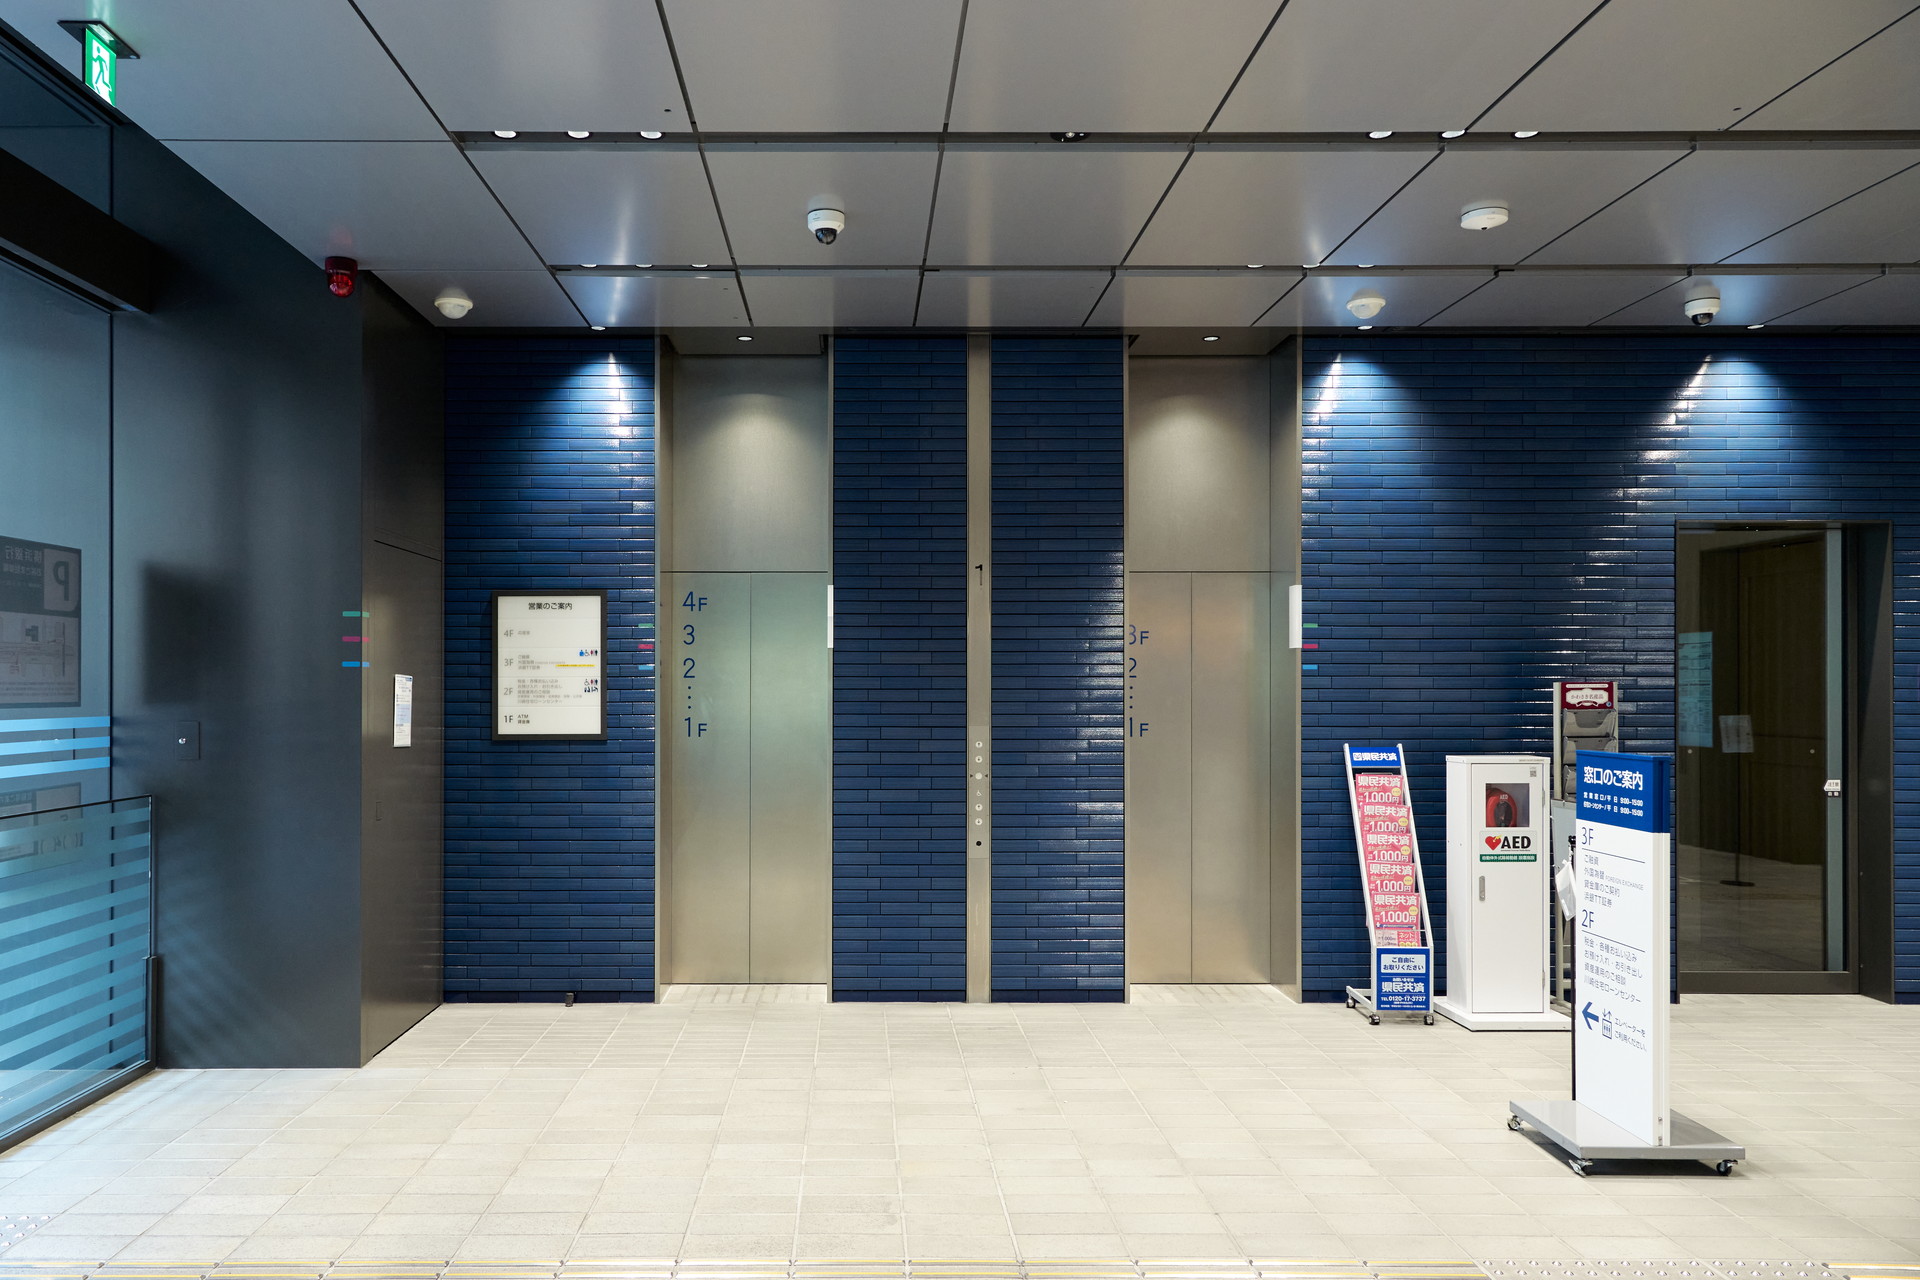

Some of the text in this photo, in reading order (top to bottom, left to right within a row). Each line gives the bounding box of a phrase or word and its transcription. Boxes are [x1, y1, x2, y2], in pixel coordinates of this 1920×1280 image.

[528, 602, 573, 611] 営業のご案内
[682, 591, 708, 612] 4F
[504, 629, 514, 637] 4F
[683, 624, 696, 645] 3
[1129, 624, 1150, 645] 3F
[504, 659, 514, 667] 3F
[683, 658, 696, 678] 2
[1129, 658, 1137, 678] 2
[504, 688, 514, 696] 2F
[504, 715, 513, 723] 1F
[684, 717, 708, 738] 1F
[1129, 717, 1149, 737] 1F
[1361, 752, 1398, 761] 県民共済
[1358, 775, 1401, 787] 県民共済
[1583, 766, 1644, 790] 窓口のご案内
[1364, 805, 1408, 817] 県民共済
[1366, 834, 1410, 846] 県民共済
[1501, 835, 1532, 849] AED
[1581, 827, 1594, 845] 3F
[1370, 863, 1412, 875] 県民共済
[1374, 894, 1417, 906] 県民共済
[1581, 909, 1594, 928] 2F
[1381, 981, 1425, 993] 県民共済
